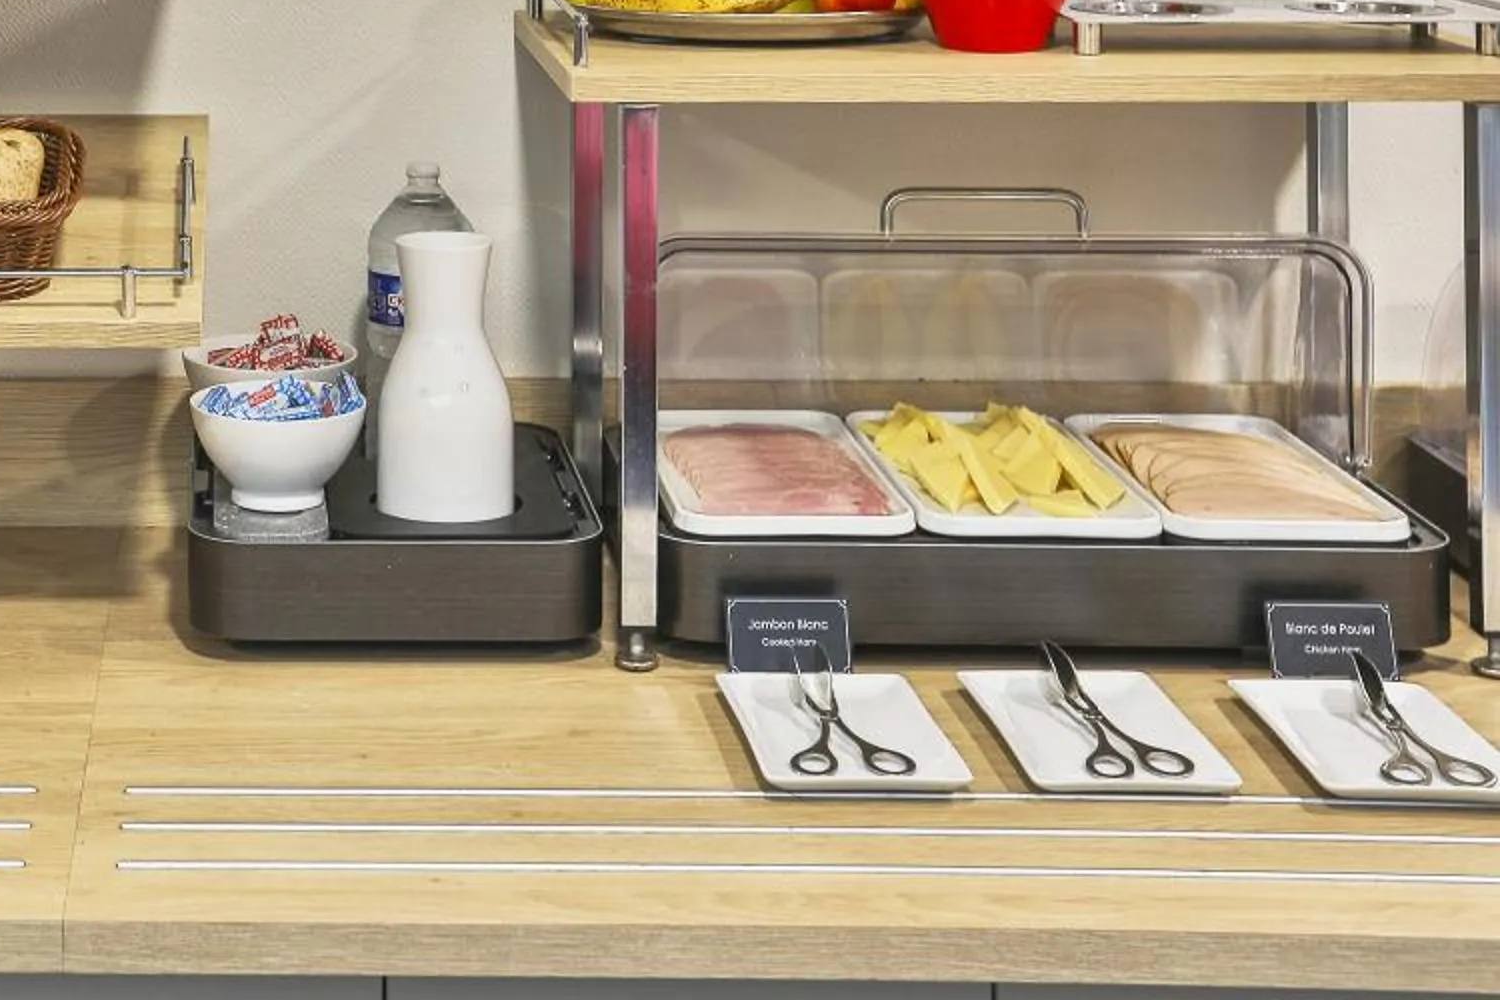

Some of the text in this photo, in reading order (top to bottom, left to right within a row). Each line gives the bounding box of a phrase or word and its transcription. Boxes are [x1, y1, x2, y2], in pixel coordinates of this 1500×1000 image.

[747, 618, 829, 631] Jambon Blanc
[1285, 621, 1376, 636] Blanc de Poulet
